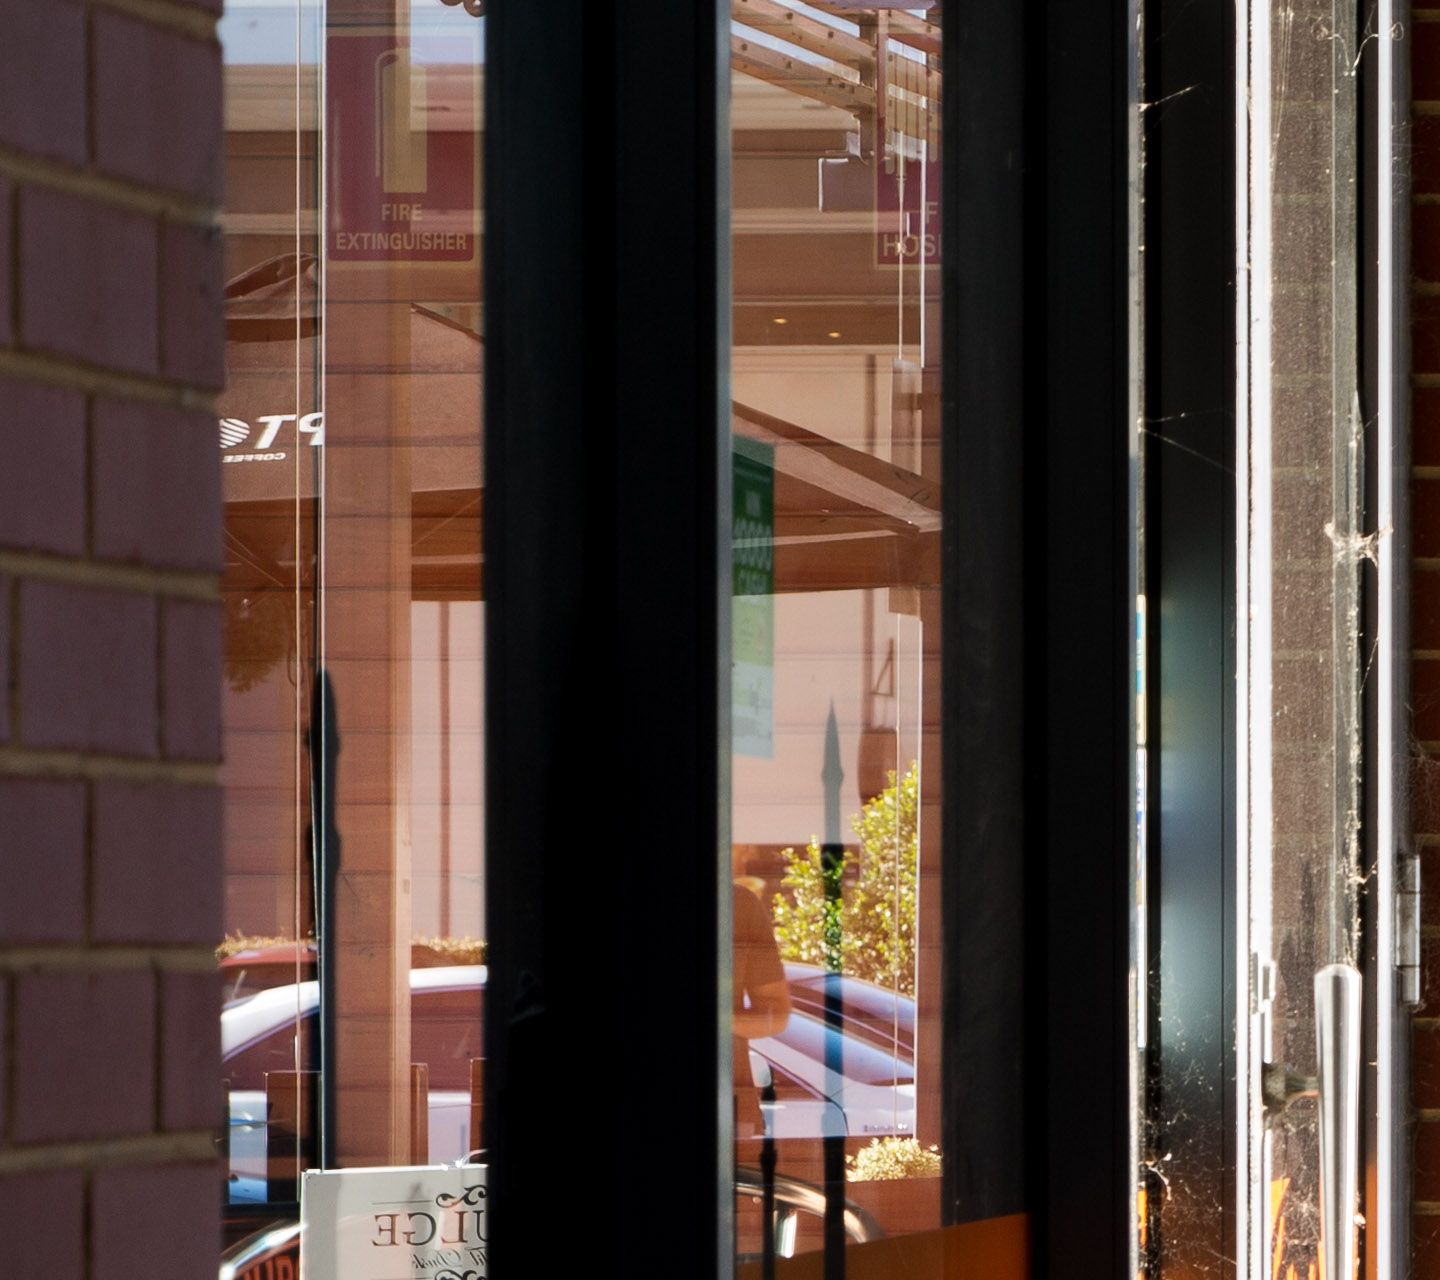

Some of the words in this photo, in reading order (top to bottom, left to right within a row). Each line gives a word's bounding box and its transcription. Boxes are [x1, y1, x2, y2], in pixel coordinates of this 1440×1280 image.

[381, 203, 423, 221] FIRE
[335, 233, 468, 251] EXTINGUISHER
[882, 233, 942, 257] HOS
